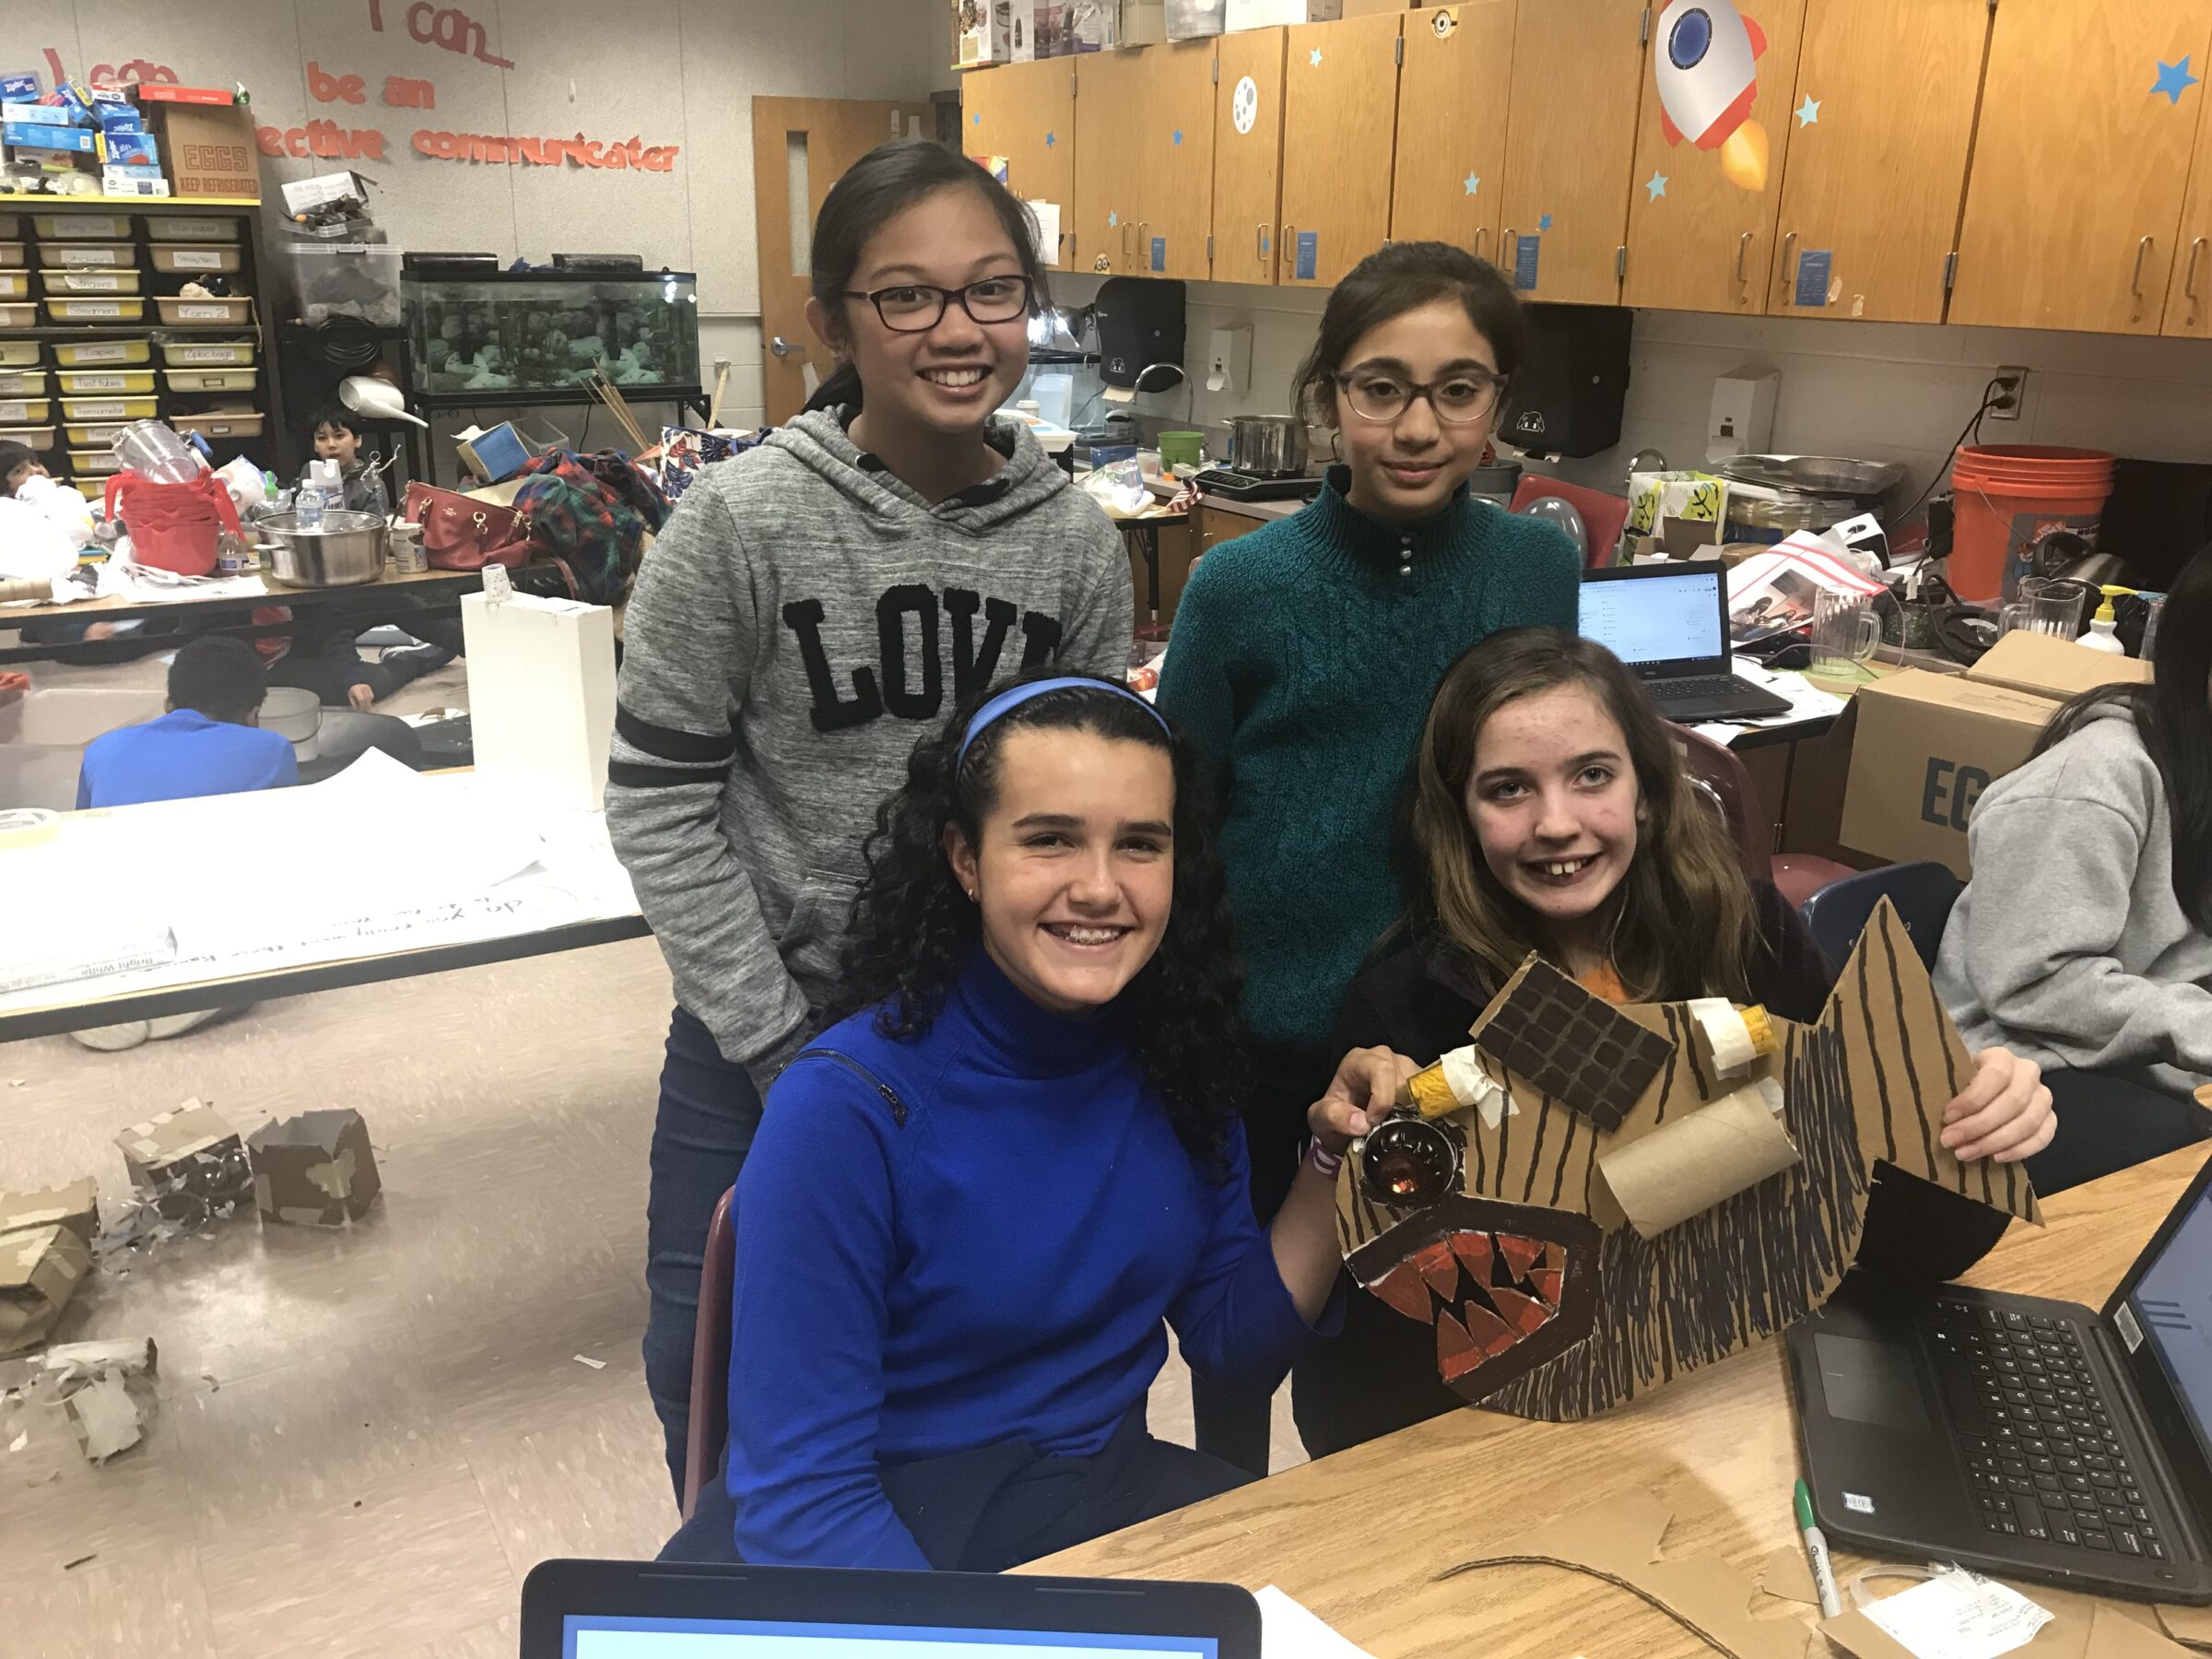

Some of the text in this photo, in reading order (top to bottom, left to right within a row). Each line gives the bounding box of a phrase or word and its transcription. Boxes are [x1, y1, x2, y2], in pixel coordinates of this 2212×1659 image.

[306, 60, 436, 110] be an
[183, 144, 249, 172] EGGS
[179, 176, 201, 193] KEEP
[202, 177, 259, 194] REFRIGERATED
[1920, 756, 1992, 834] EG
[80, 964, 116, 977] White
[117, 957, 155, 971] Bright
